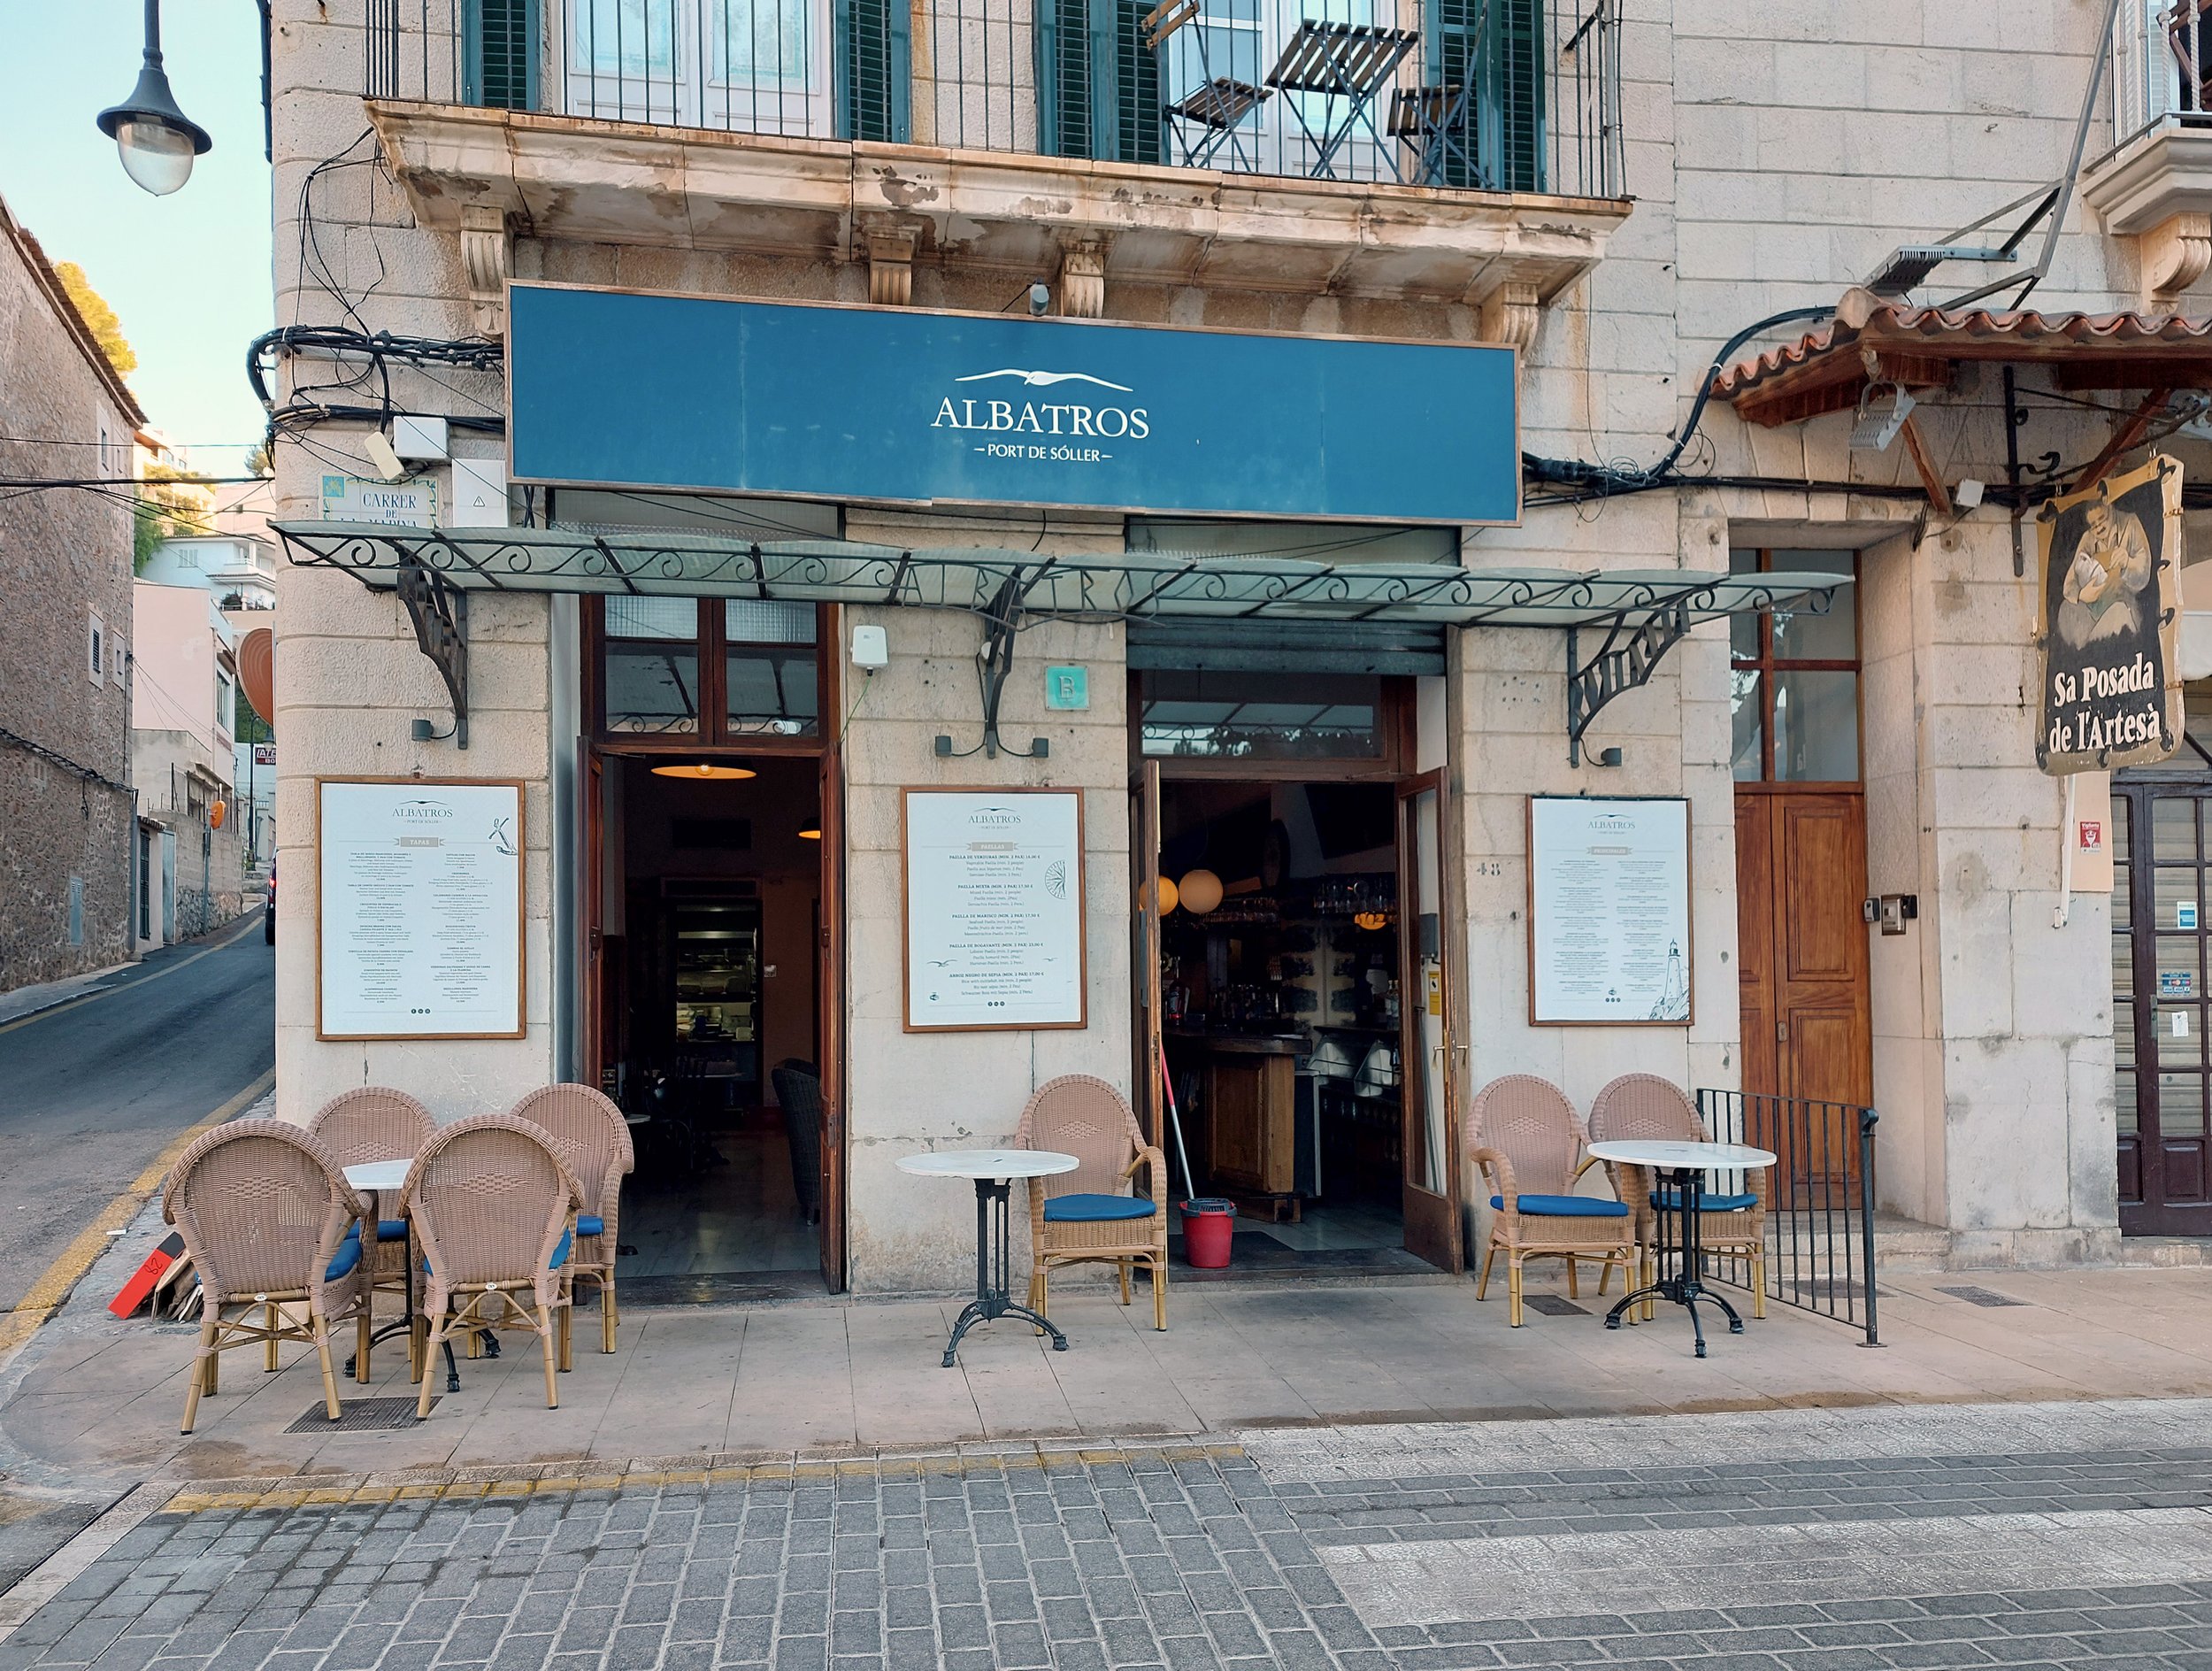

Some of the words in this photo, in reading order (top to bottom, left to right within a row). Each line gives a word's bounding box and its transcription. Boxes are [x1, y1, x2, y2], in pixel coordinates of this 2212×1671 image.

[930, 397, 1149, 439] ALBATROS
[987, 443, 1025, 458] PORT
[1028, 446, 1047, 459] DE
[1050, 445, 1100, 462] SÓLLER
[363, 493, 417, 509] CARRER
[386, 510, 397, 519] DE
[2054, 673, 2077, 707] Sa
[2081, 651, 2154, 702] Posada
[2049, 717, 2072, 753] de
[2078, 703, 2162, 751] l'Artesà
[392, 808, 453, 818] ALBATROS
